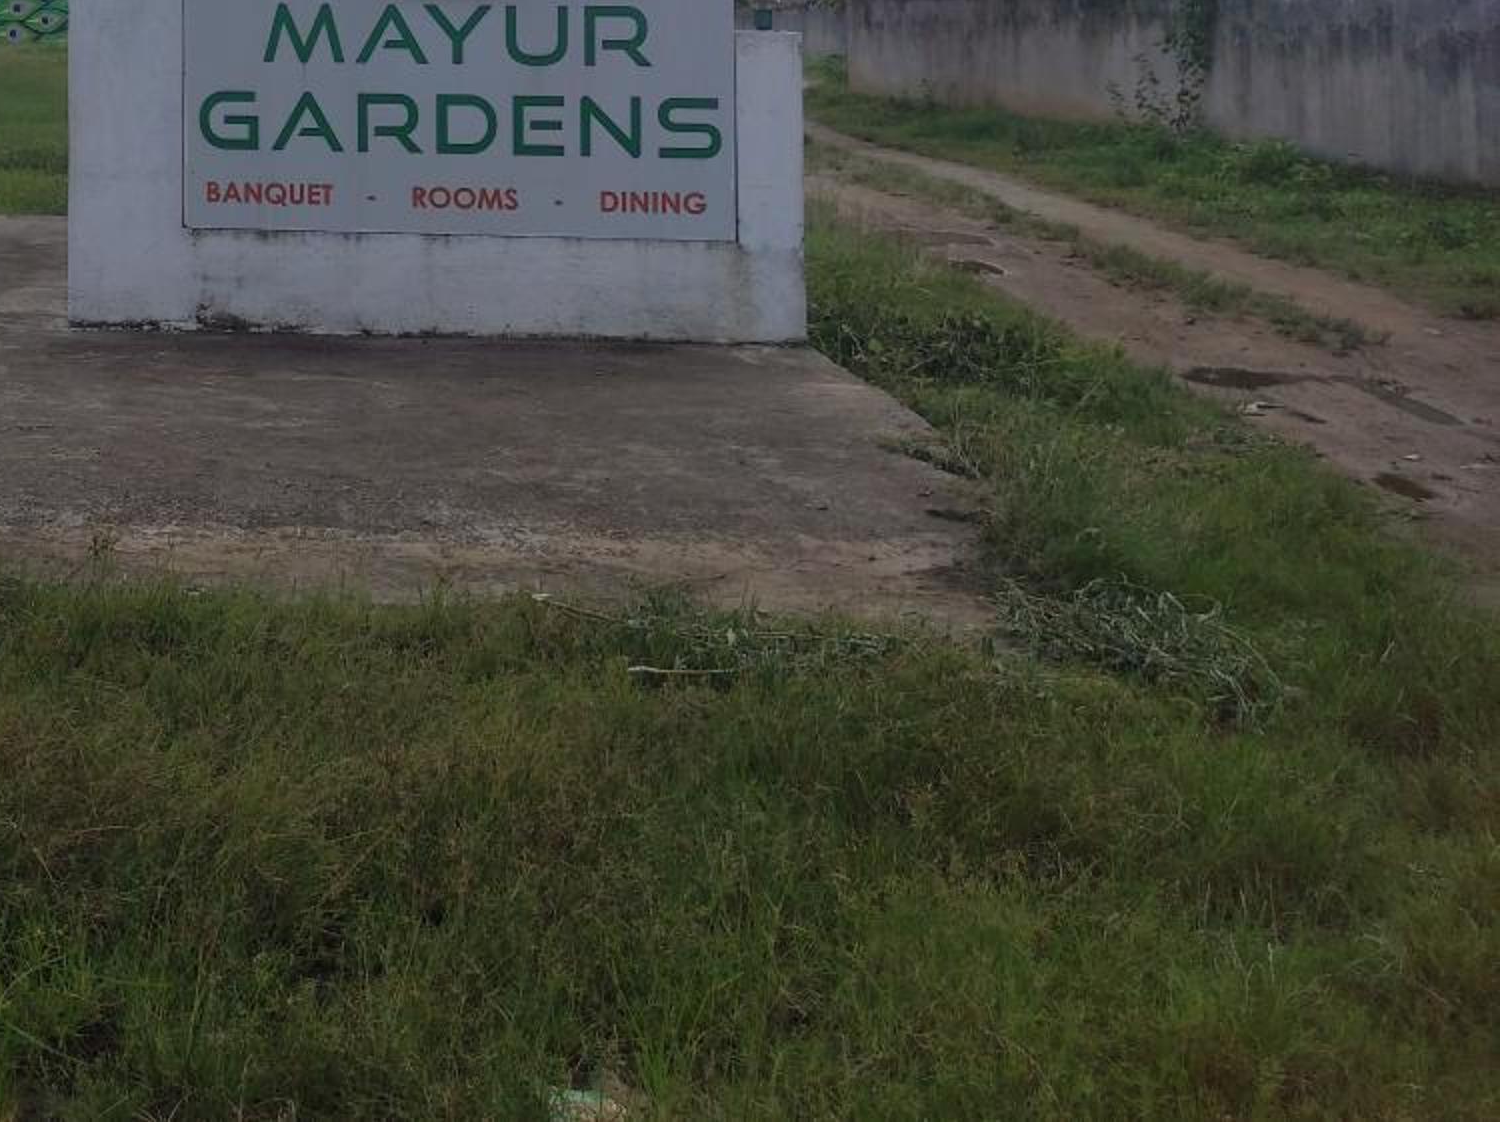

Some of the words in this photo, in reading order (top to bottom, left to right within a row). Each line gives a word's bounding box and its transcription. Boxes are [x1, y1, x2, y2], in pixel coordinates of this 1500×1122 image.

[263, 2, 652, 68] MAYUR
[198, 90, 723, 160] GARDENS
[205, 181, 334, 208] BANQUET
[411, 185, 520, 212] ROOMS
[599, 190, 708, 216] DINING
